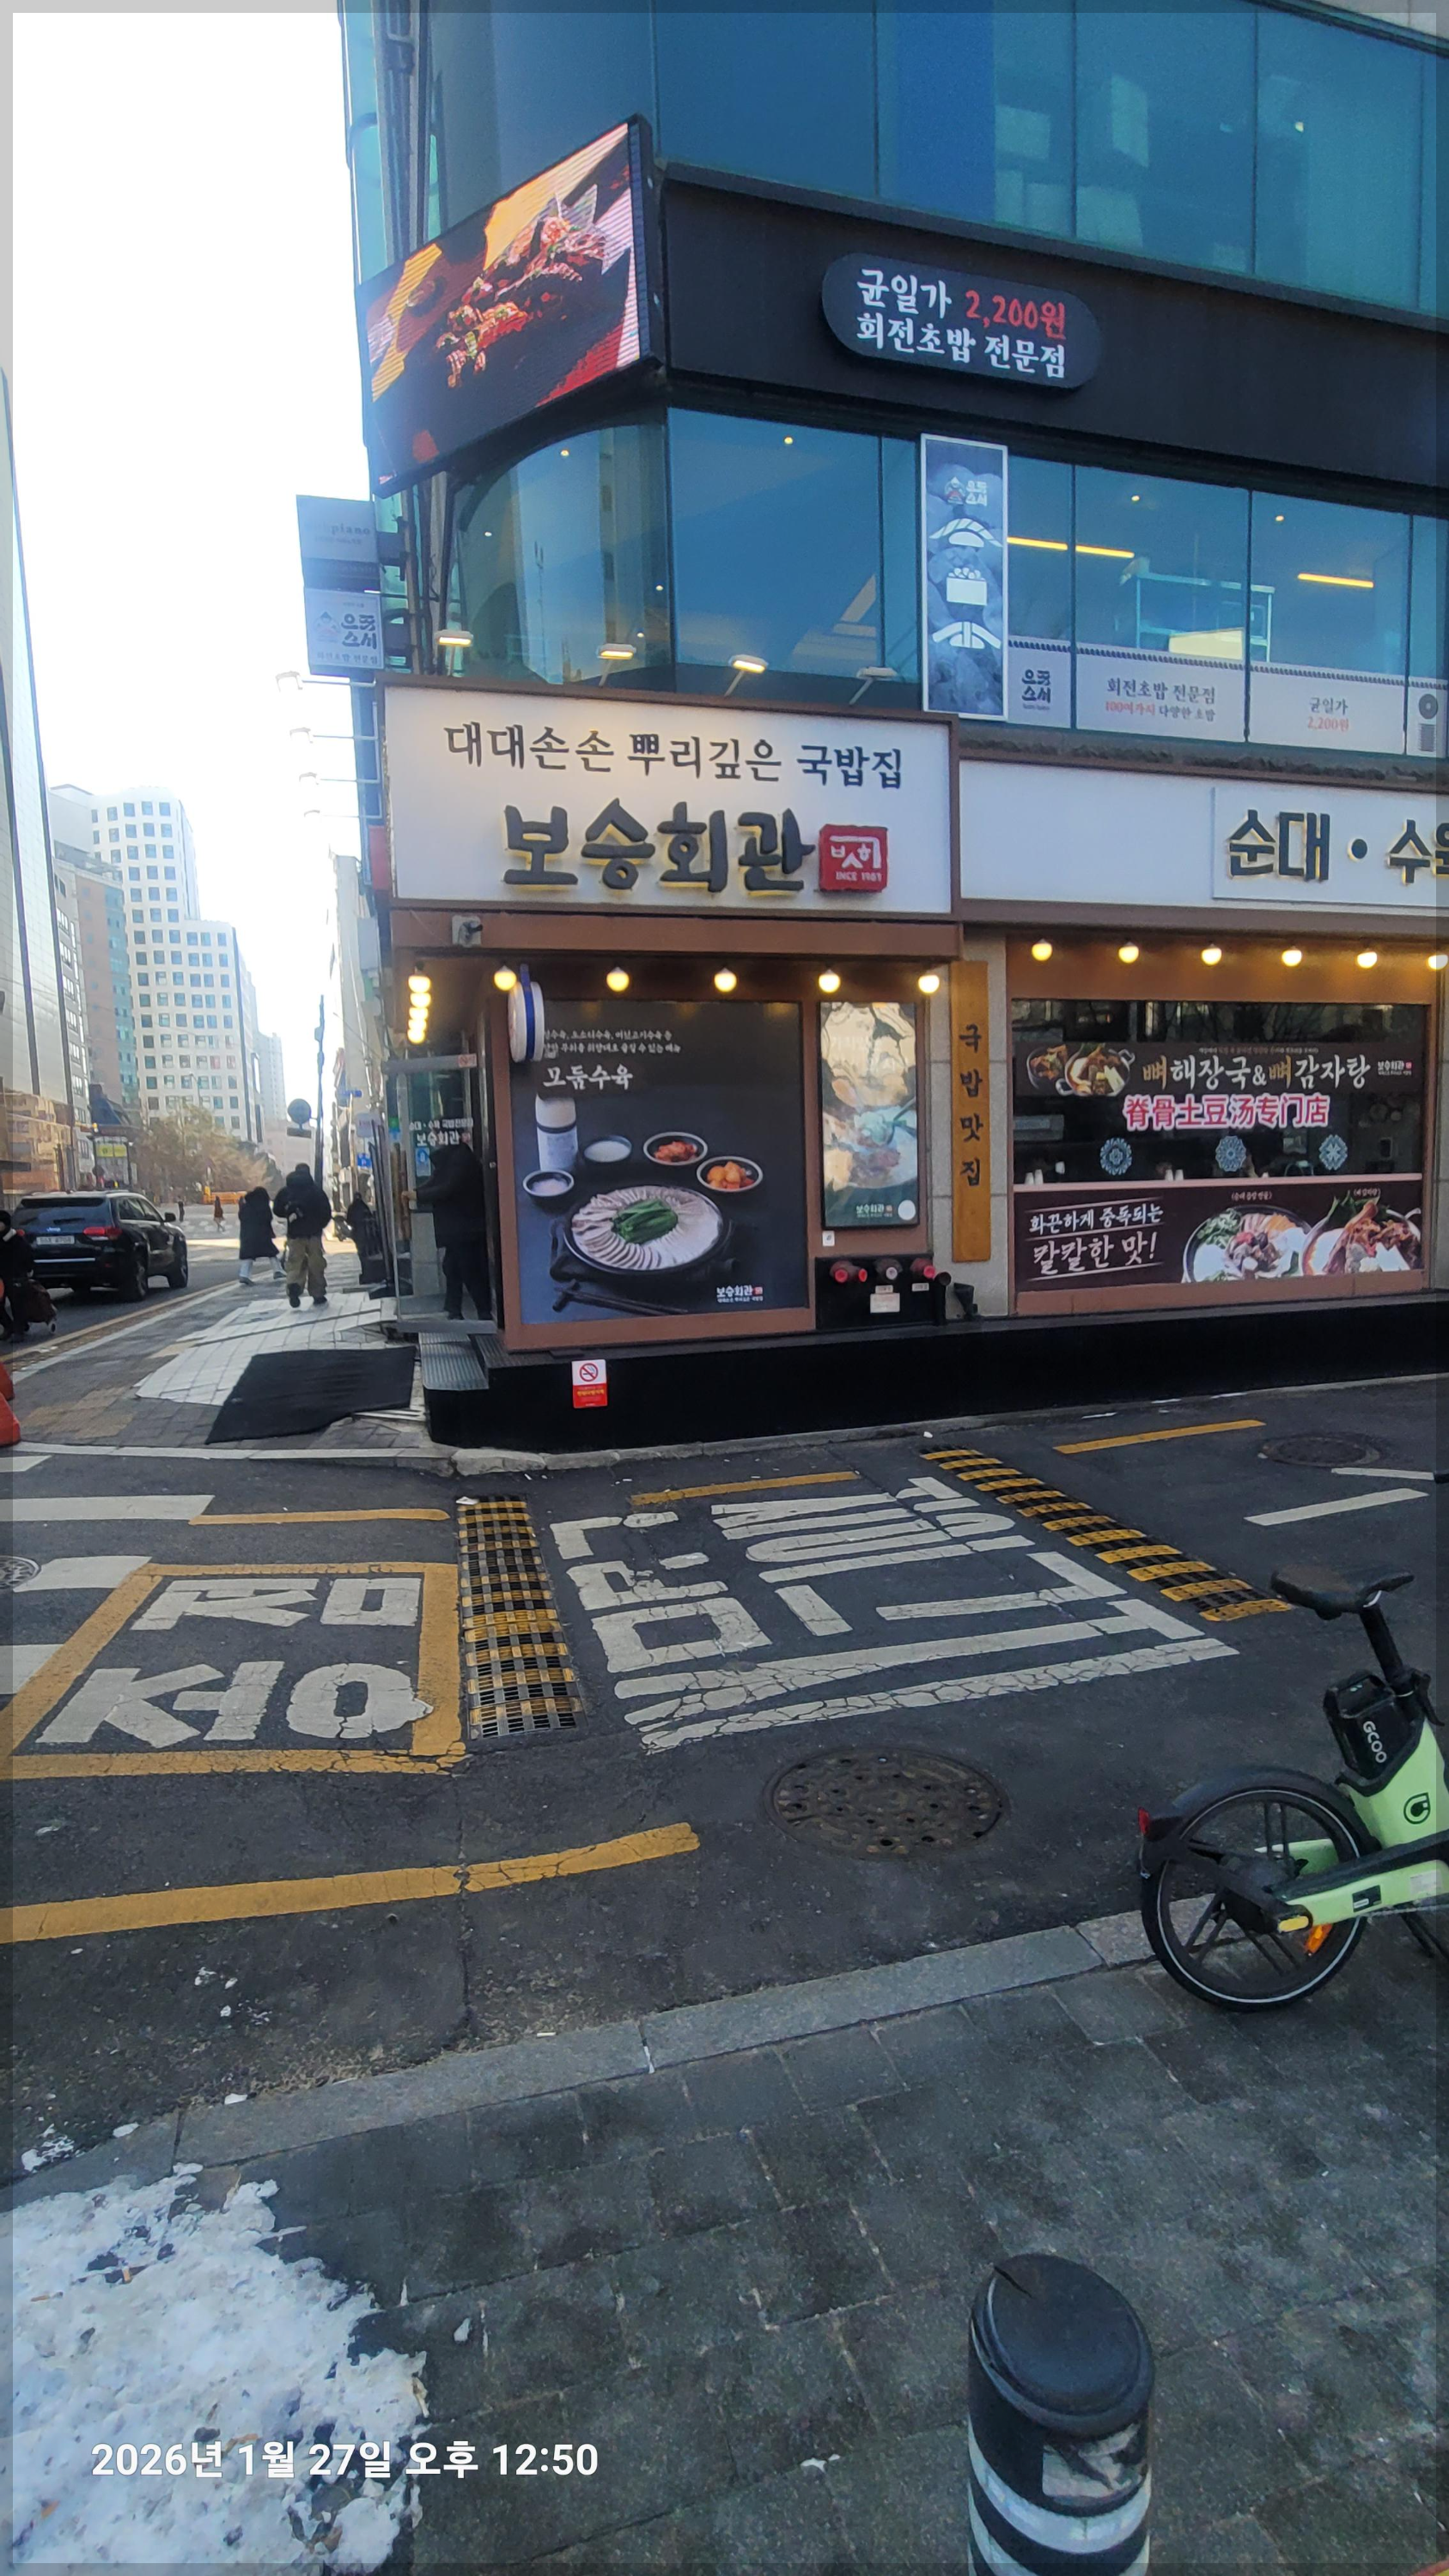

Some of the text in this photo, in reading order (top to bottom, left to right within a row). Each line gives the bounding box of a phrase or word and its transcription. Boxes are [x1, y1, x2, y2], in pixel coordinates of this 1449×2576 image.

[857, 269, 1066, 340] 균일가 2,200원
[857, 313, 1064, 379] 회전초밥 전문점
[1107, 677, 1215, 704] 회전초밥 전문점
[1309, 697, 1349, 716] 균일가
[1307, 716, 1349, 732] 2,200원
[444, 721, 902, 789] 대대손손 뿌리깊은 국밥집
[503, 798, 816, 892] 보승회관
[1229, 810, 1330, 880] 순대
[1124, 1095, 1330, 1130] 脊骨土豆汤专门店
[1029, 1203, 1163, 1236] 화끈하게 중독되는
[1033, 1230, 1157, 1275] 칼칼한 맛!
[1363, 1721, 1387, 1764] GCOO
